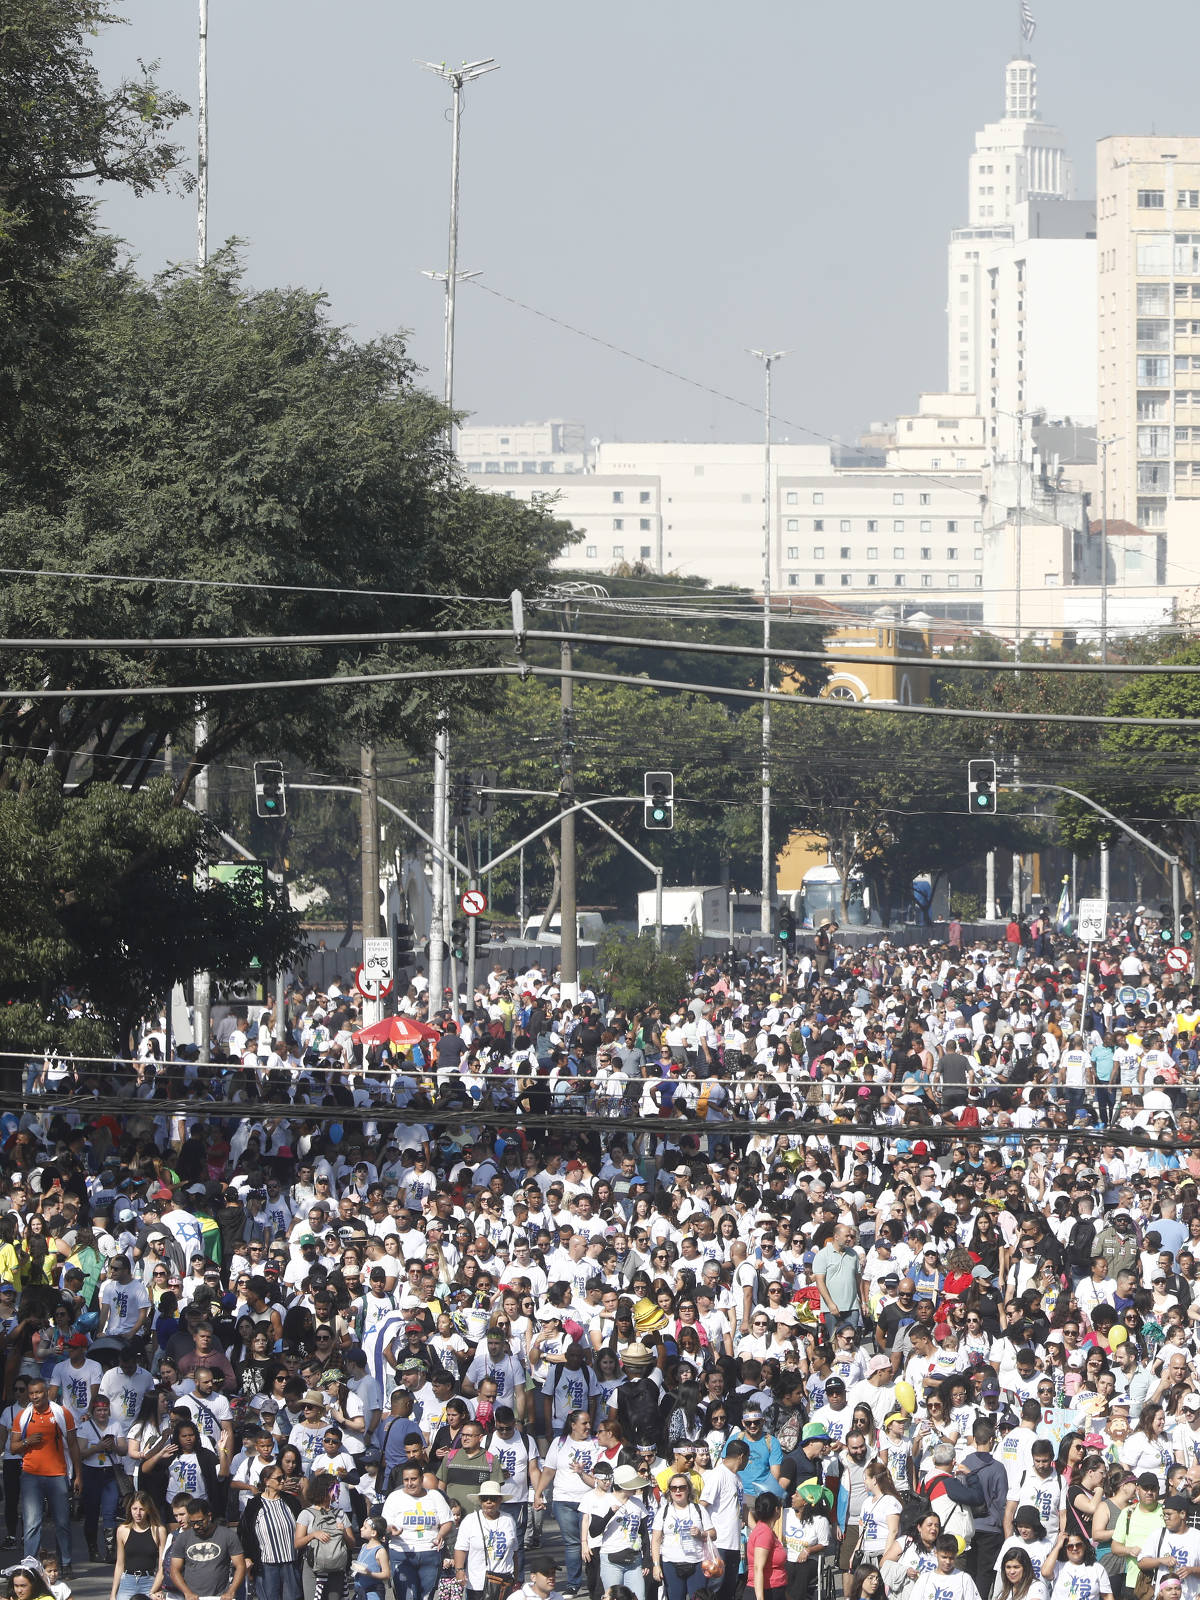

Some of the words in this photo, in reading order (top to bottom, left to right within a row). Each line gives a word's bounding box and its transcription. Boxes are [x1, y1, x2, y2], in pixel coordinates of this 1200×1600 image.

[77, 1381, 87, 1408] JESUS
[127, 1393, 136, 1416] JESUS
[571, 1382, 582, 1408] JESUS
[185, 1463, 196, 1492] JESUS
[1042, 1493, 1052, 1521] JESUS
[496, 1531, 506, 1559] JESUS
